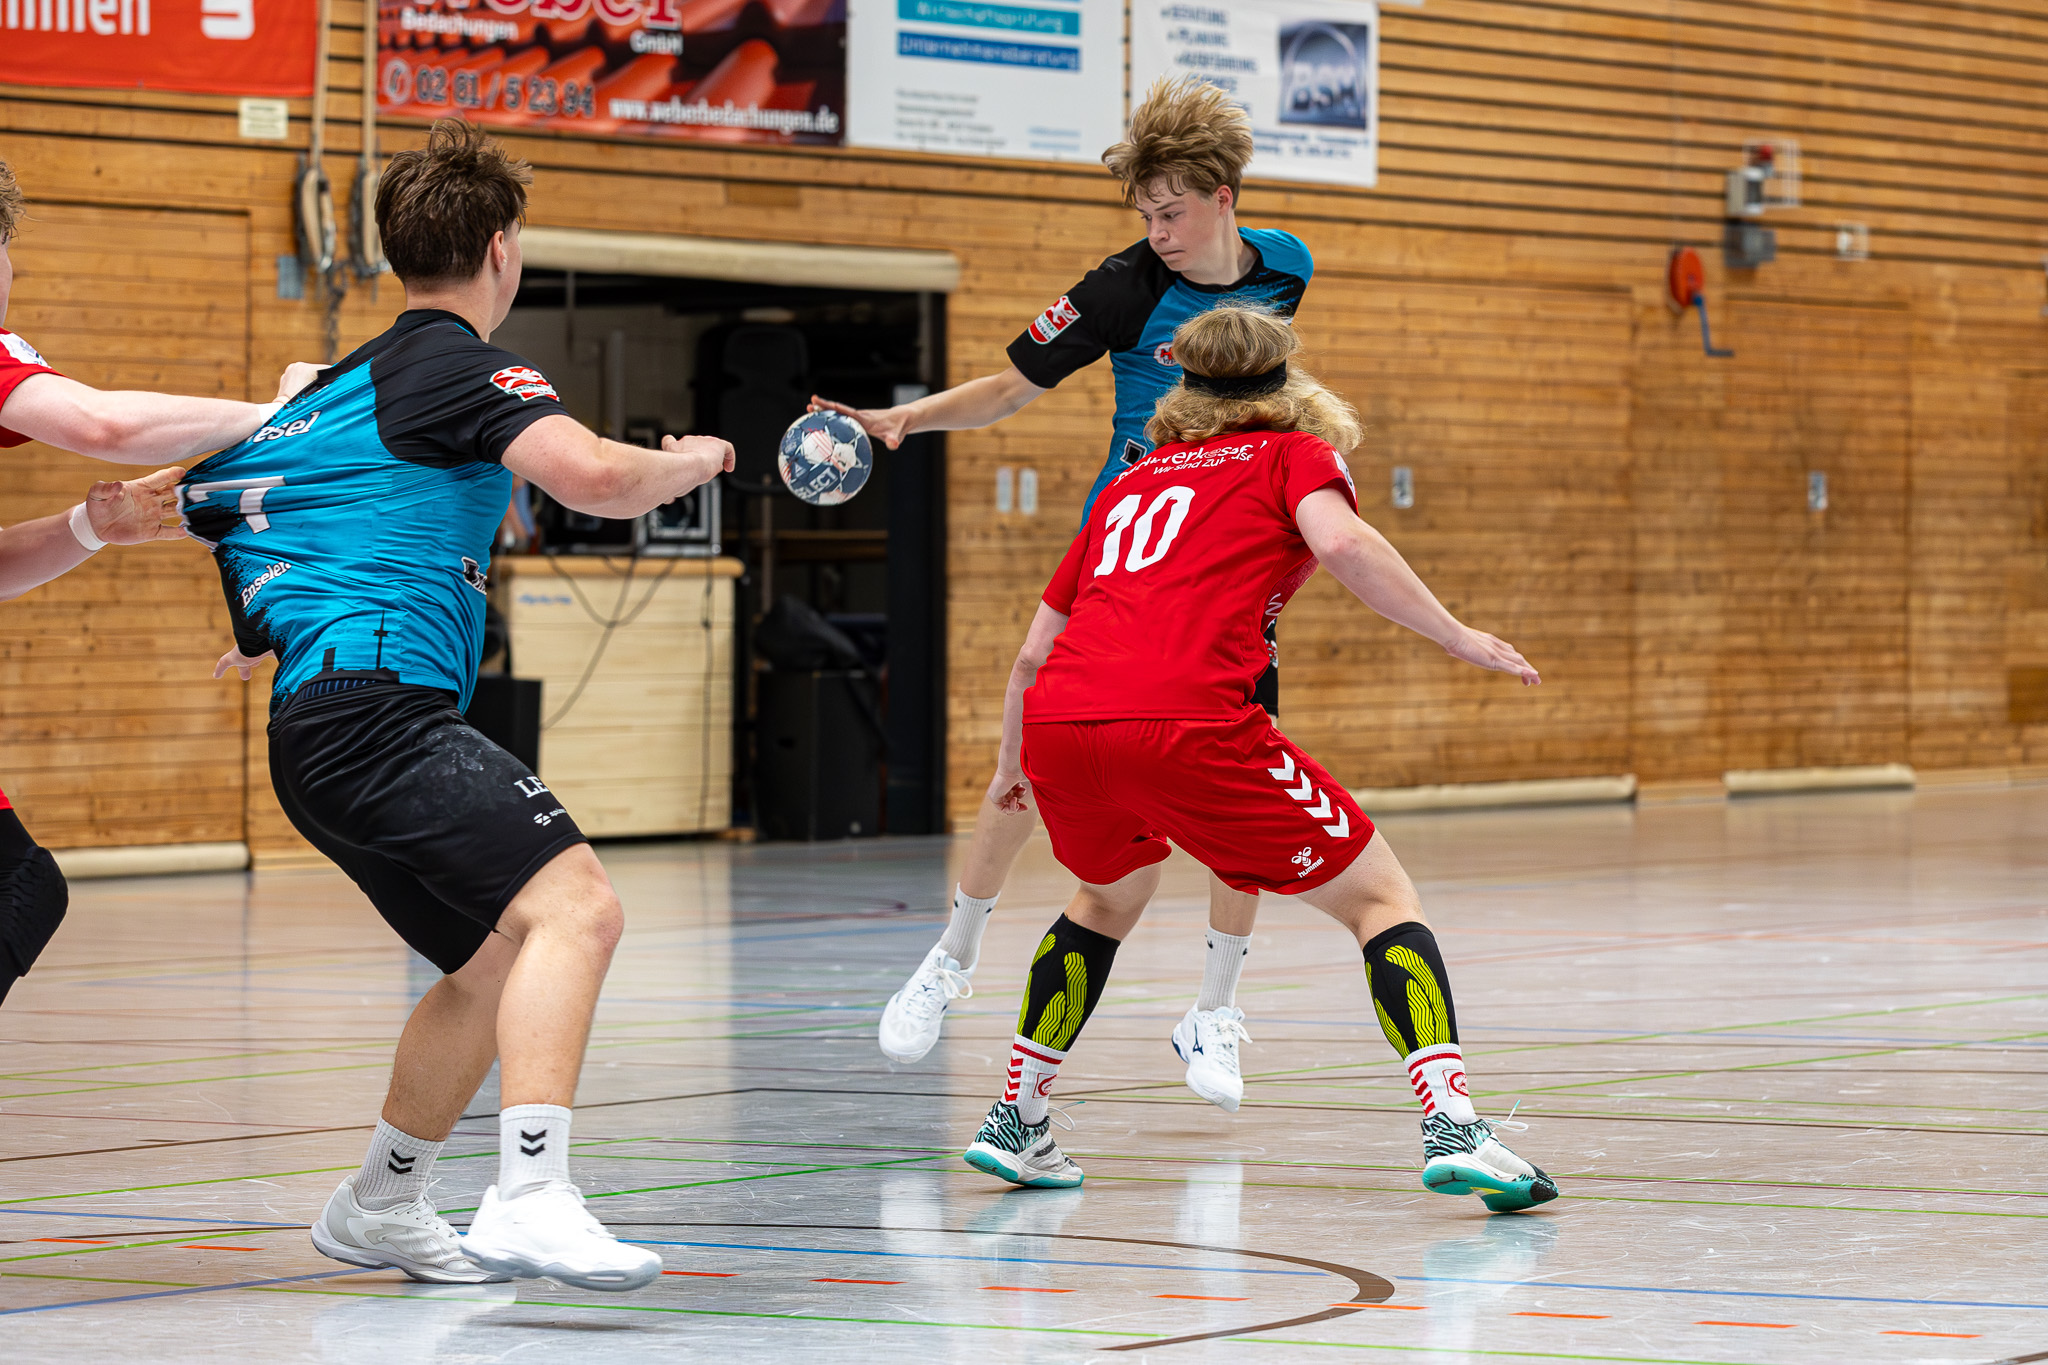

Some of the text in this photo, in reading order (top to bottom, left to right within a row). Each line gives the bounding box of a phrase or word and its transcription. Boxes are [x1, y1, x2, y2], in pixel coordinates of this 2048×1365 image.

[402, 7, 519, 43] Bedachungen
[630, 29, 684, 55] GmbH
[246, 411, 322, 444] esel
[1173, 460, 1203, 472] sind
[1093, 485, 1196, 579] 10
[1297, 855, 1325, 878] hummel
